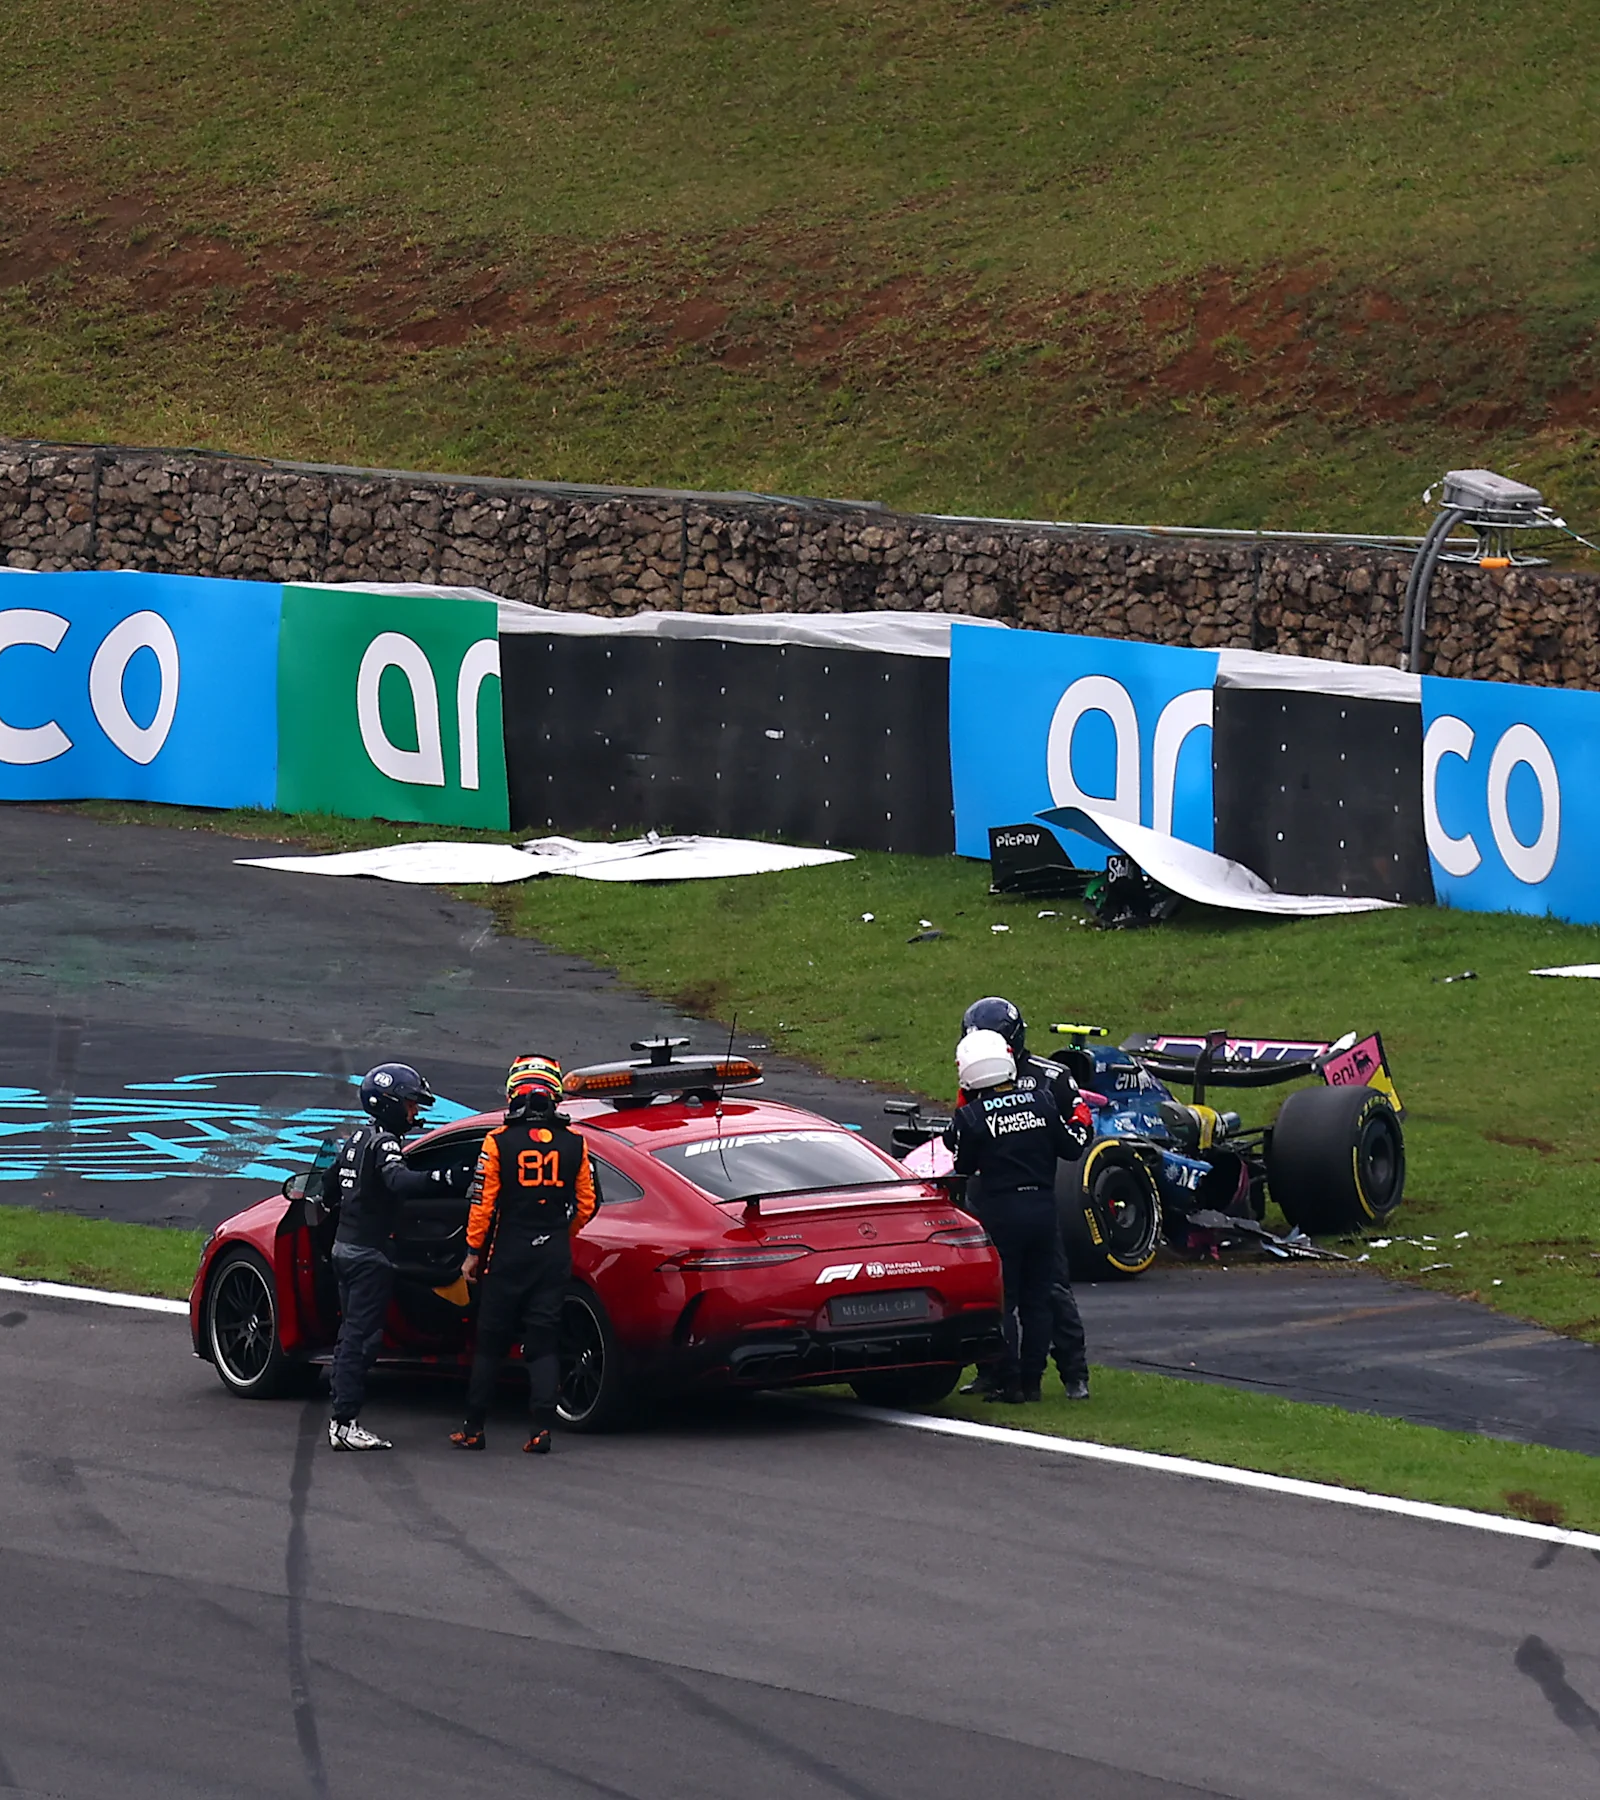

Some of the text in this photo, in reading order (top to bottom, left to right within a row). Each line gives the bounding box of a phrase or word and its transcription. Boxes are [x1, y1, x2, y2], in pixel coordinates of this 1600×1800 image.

[1423, 714, 1561, 885] co
[996, 833, 1041, 848] PicPay
[374, 1073, 392, 1087] FIA
[1332, 1058, 1355, 1086] eni
[1017, 1078, 1036, 1089] FIA
[983, 1092, 1035, 1112] DOCTOR
[997, 1110, 1035, 1126] SANCTA
[998, 1117, 1047, 1135] MAGGIORI
[517, 1149, 565, 1188] 81
[815, 1263, 863, 1285] F1
[866, 1263, 886, 1278] FIA
[843, 1300, 916, 1316] MEDICAL CAR
